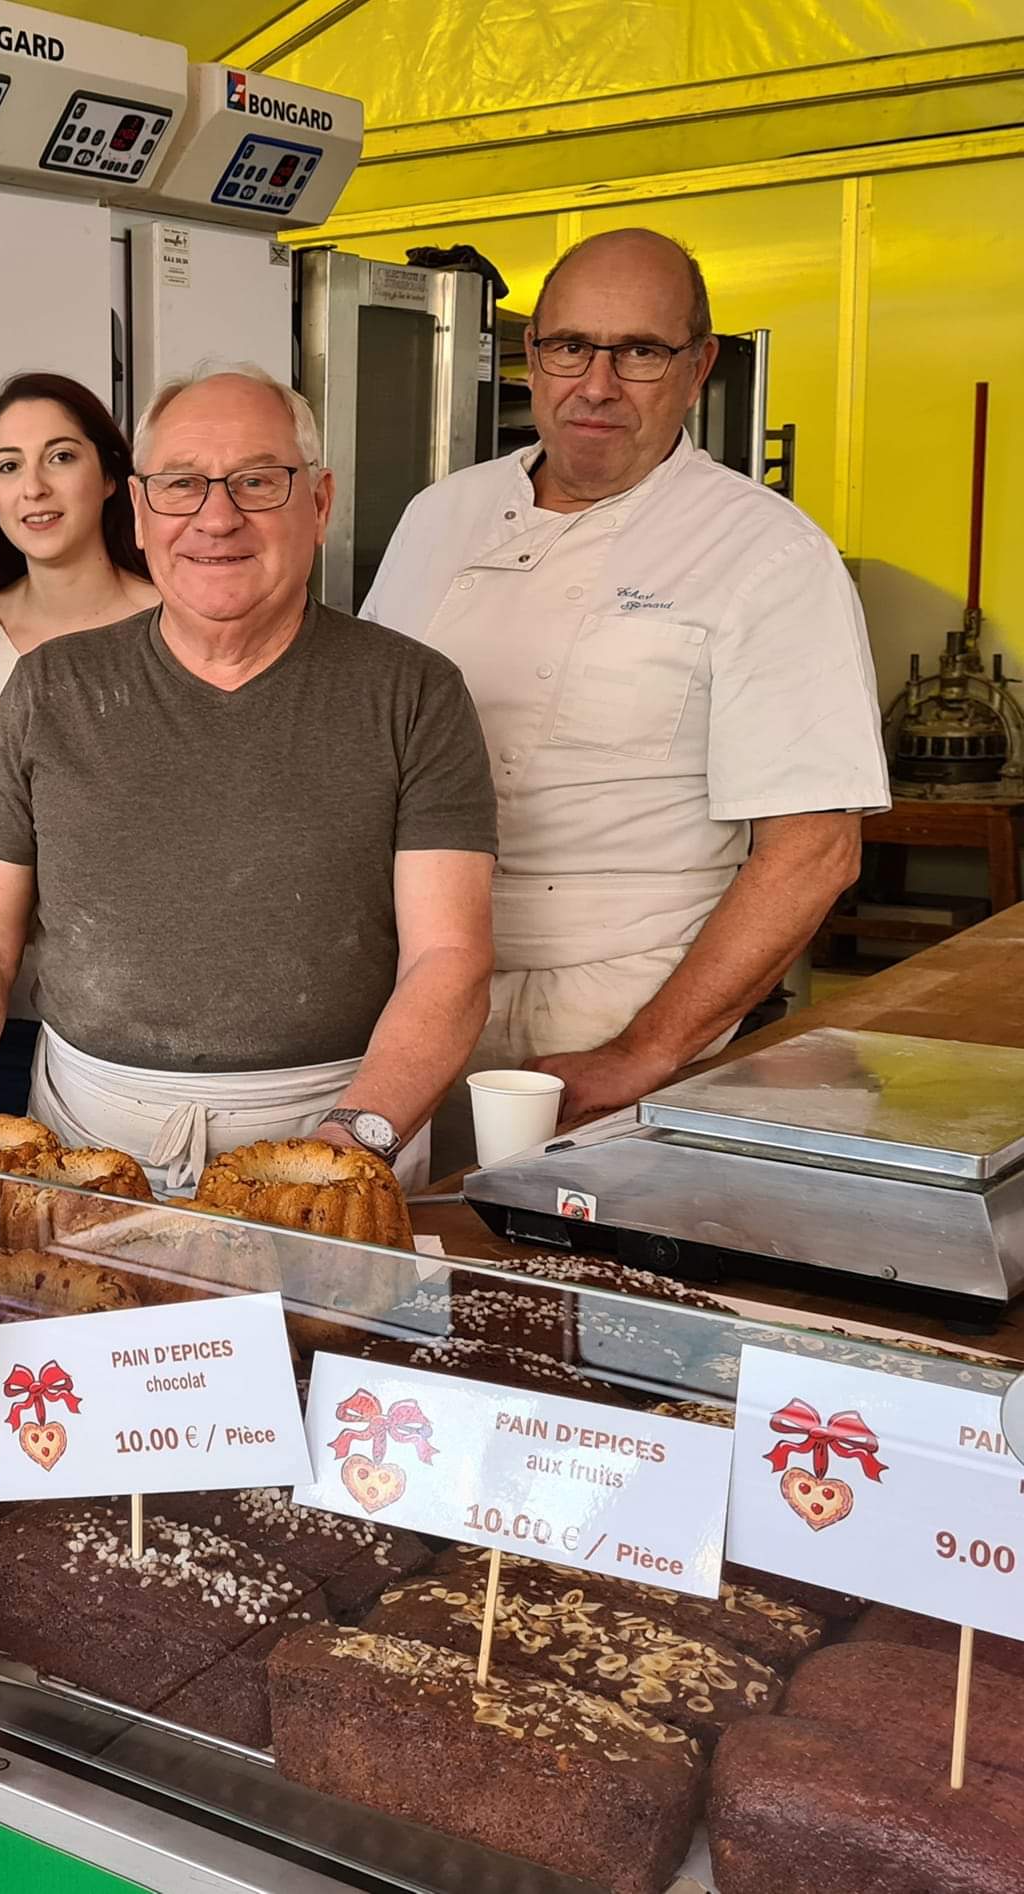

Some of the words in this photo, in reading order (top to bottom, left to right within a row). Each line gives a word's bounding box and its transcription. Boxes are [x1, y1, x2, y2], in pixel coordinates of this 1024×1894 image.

[249, 94, 333, 131] BONGARD
[111, 1349, 151, 1369] PAIN
[153, 1339, 233, 1365] D'EPICES
[145, 1372, 207, 1393] chocolat
[114, 1427, 178, 1454] 10.00
[184, 1425, 200, 1449] €
[224, 1425, 276, 1447] Pièce
[494, 1410, 549, 1442] PAIN
[554, 1422, 666, 1464] D'EPICES
[525, 1452, 563, 1477] aux
[569, 1458, 625, 1489] fruits
[463, 1501, 553, 1546] 10.00
[561, 1525, 582, 1552] €
[615, 1541, 684, 1577] Pièce
[935, 1530, 1016, 1574] 9.00
